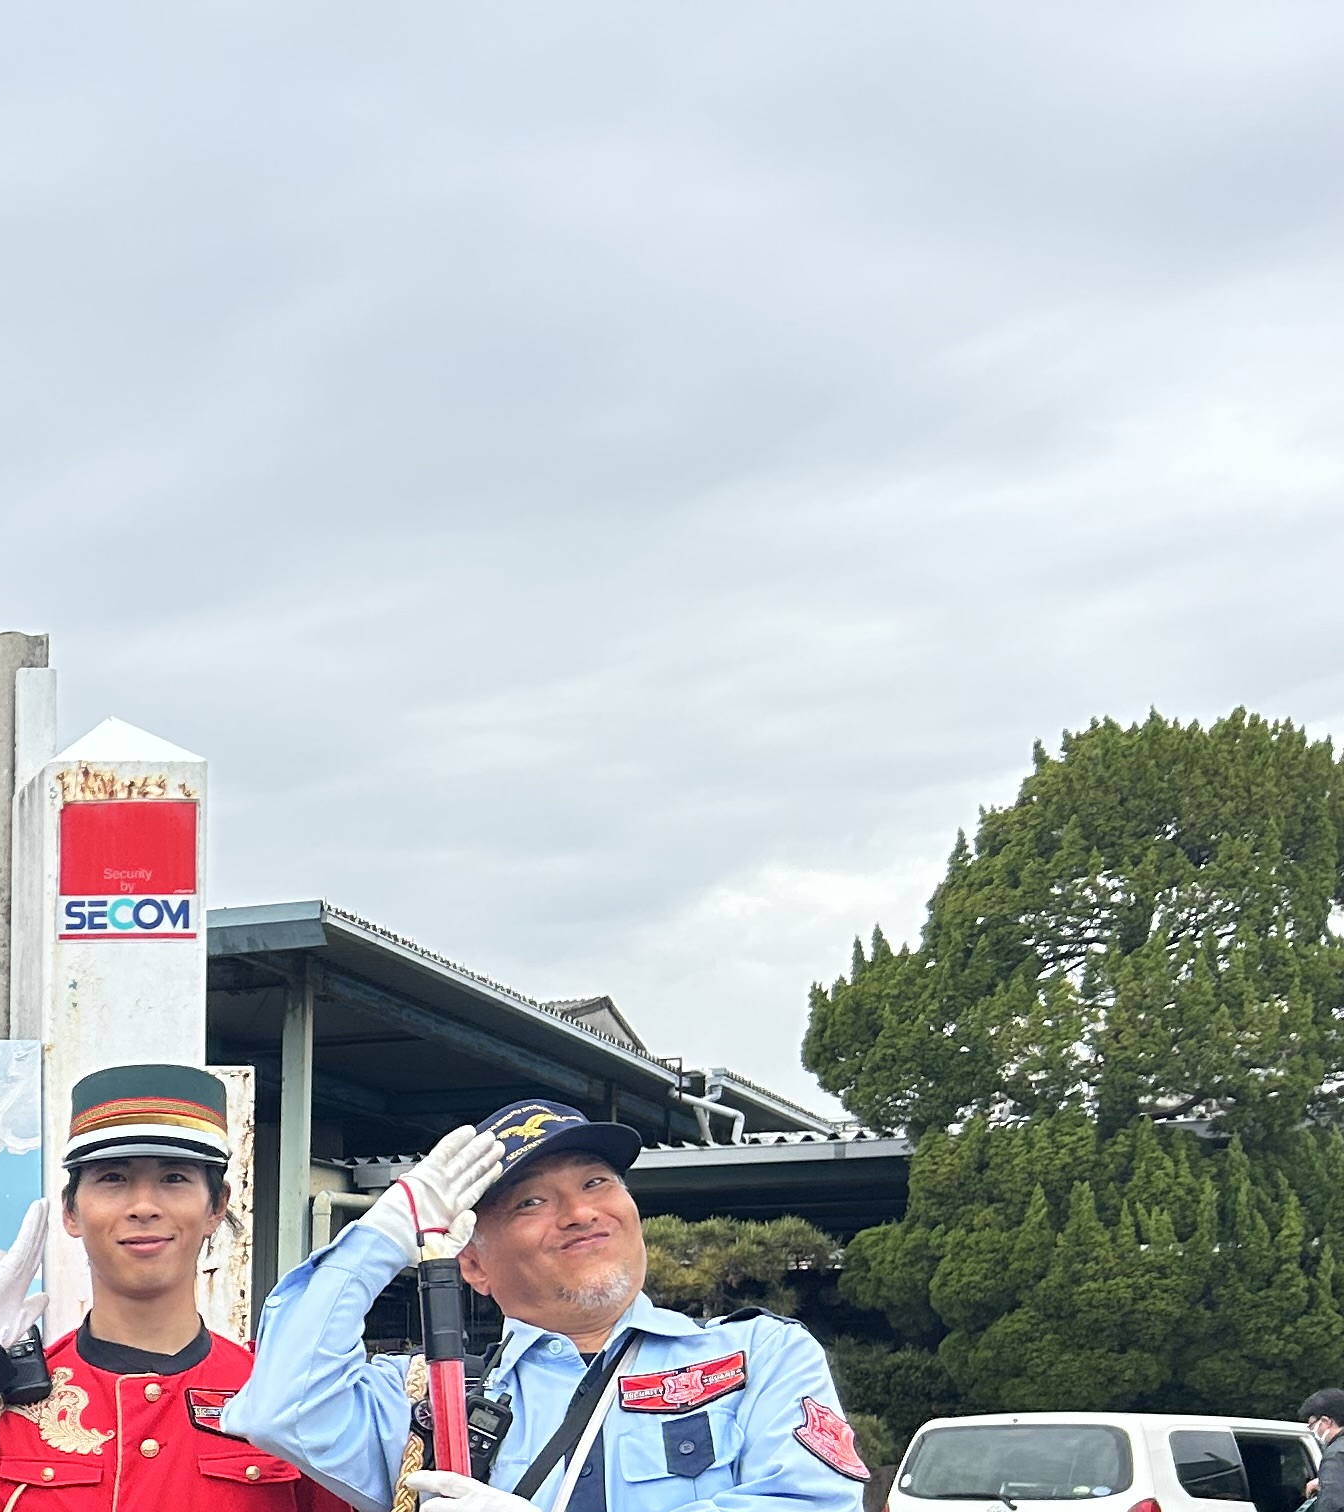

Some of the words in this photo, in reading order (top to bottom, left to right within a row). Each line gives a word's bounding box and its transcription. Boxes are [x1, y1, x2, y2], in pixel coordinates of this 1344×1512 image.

[103, 868, 153, 882] Security
[120, 881, 135, 893] by
[65, 898, 190, 931] SECOM
